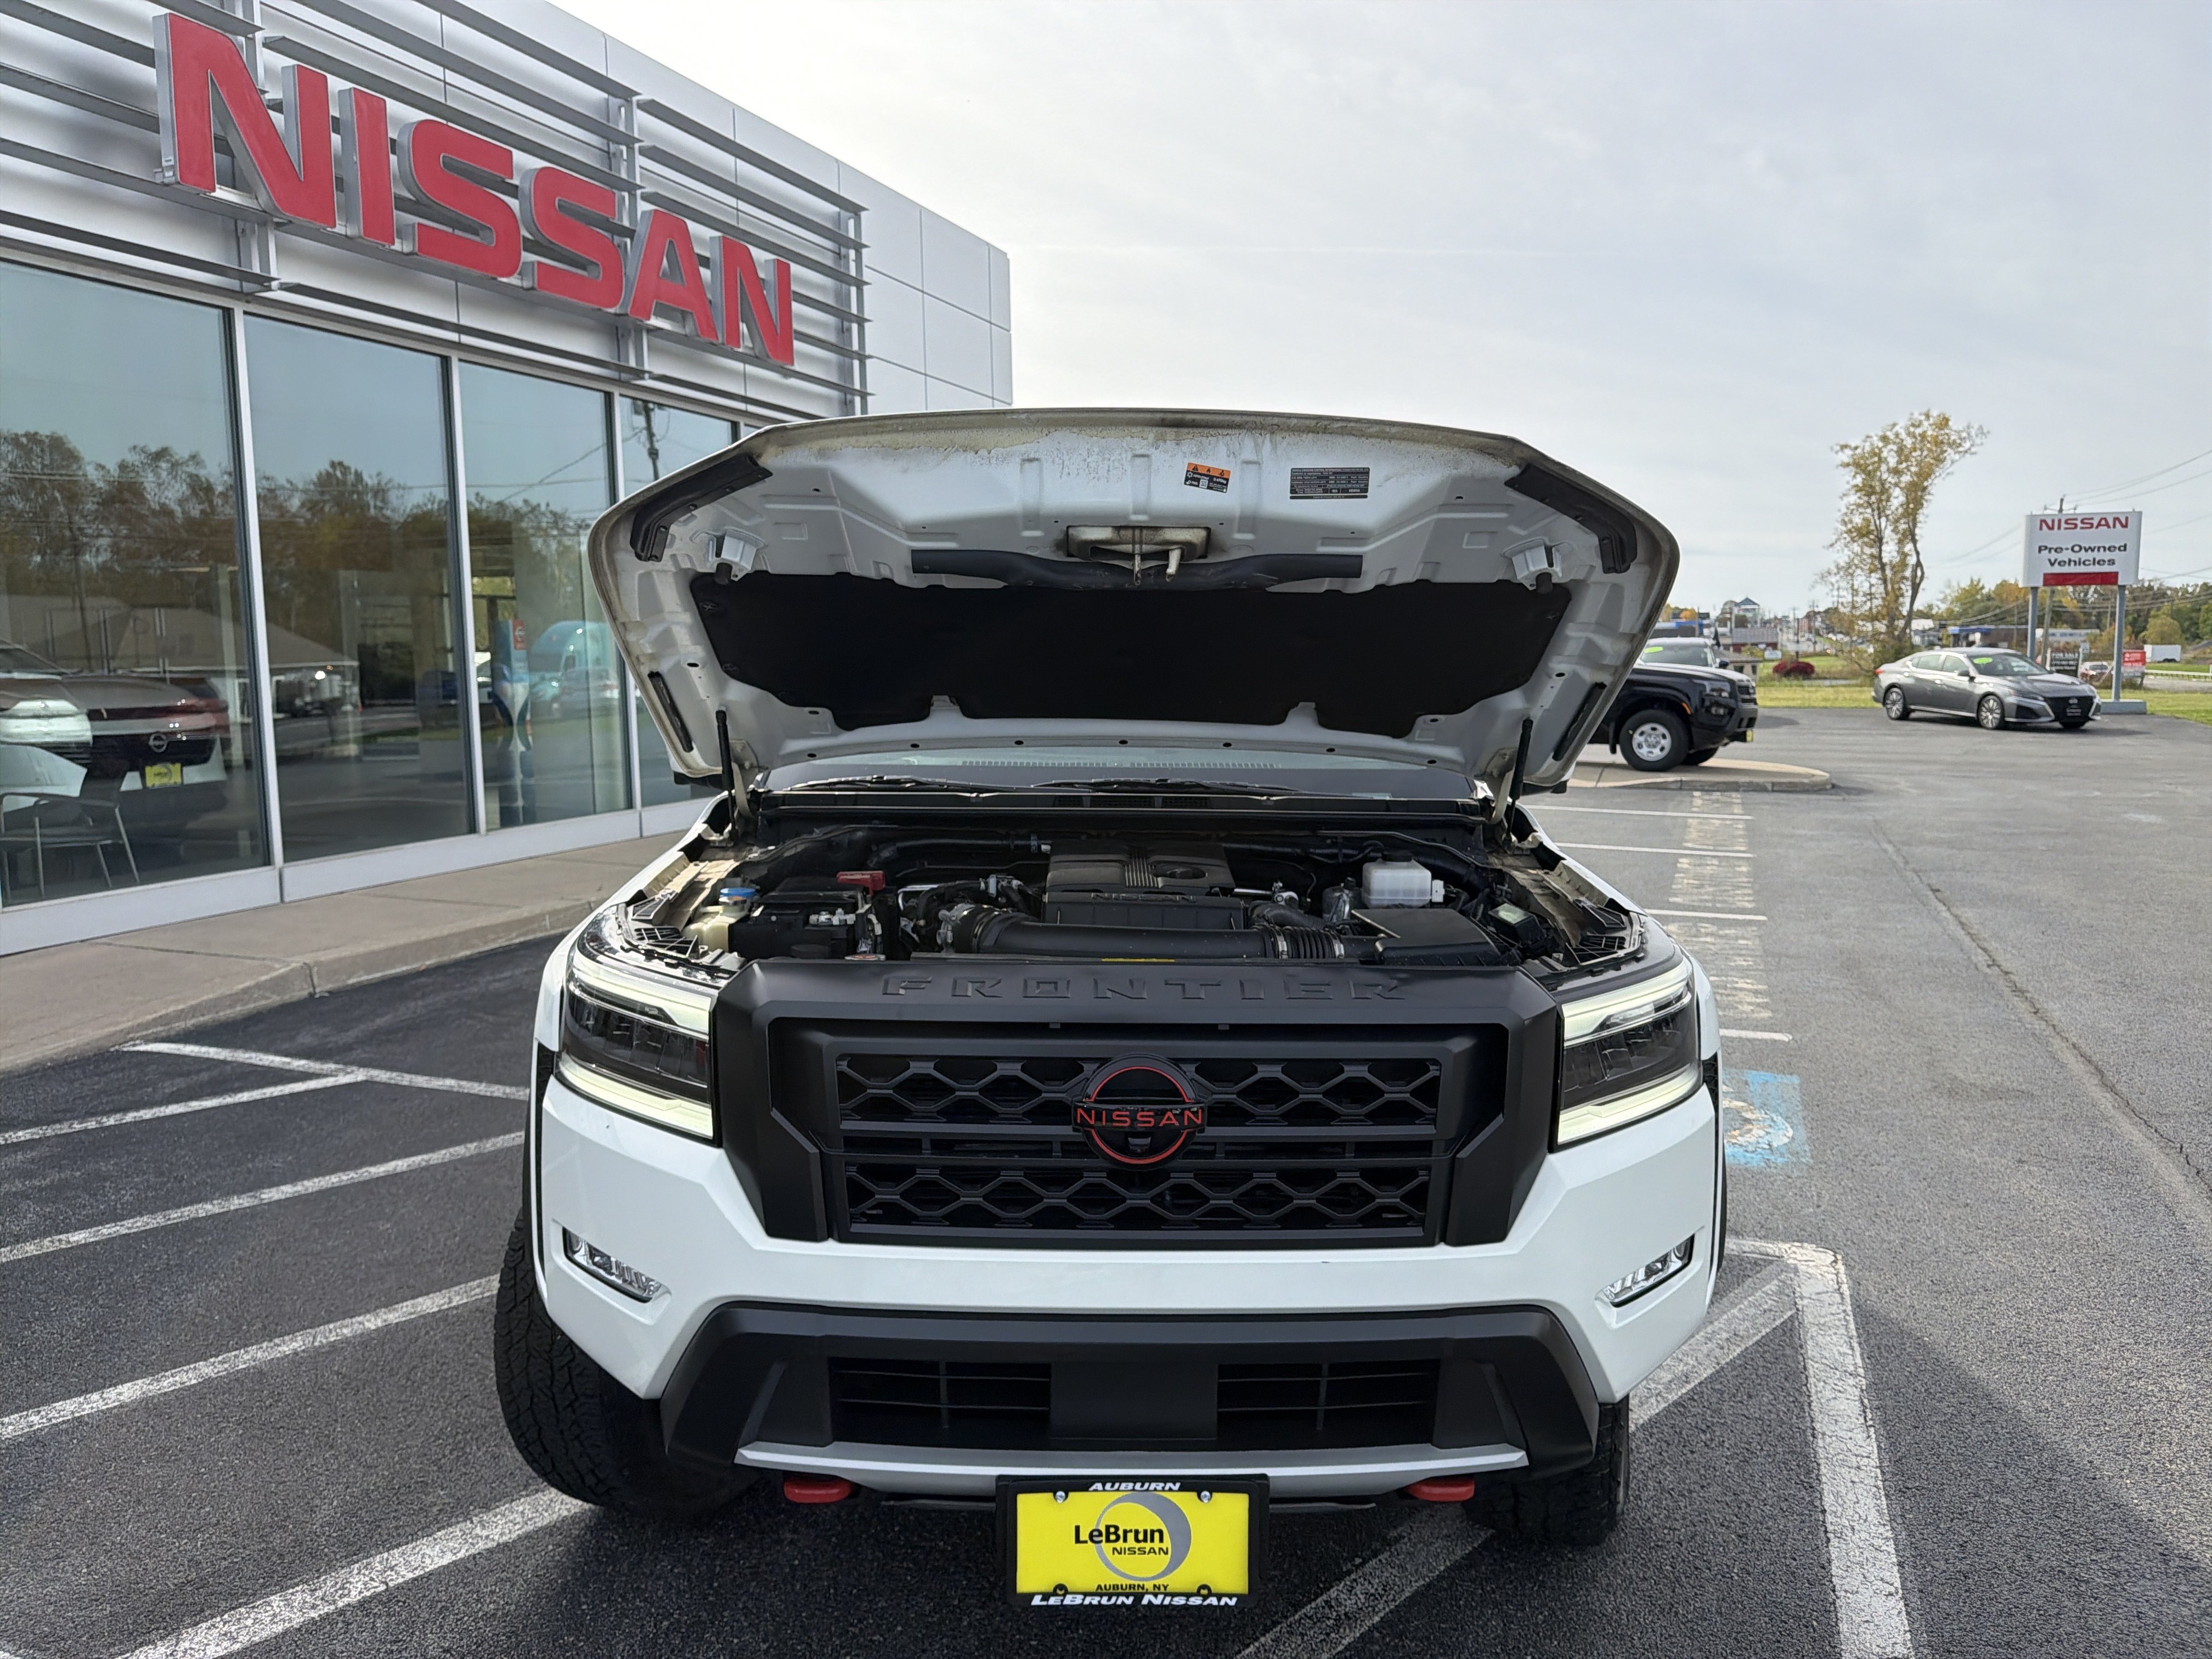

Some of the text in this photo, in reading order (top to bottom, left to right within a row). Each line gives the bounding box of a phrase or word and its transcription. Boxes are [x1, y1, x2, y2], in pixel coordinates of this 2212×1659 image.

[154, 11, 795, 367] NISSAN
[2039, 516, 2129, 531] NISSAN
[2038, 543, 2128, 555] Pre-Owned
[2047, 557, 2116, 567] Vehicles
[881, 977, 1406, 1000] FRONTIER
[1076, 1108, 1202, 1127] NISSAN
[1088, 1482, 1181, 1491] AUBURN
[1074, 1525, 1164, 1544] LeBrun
[1112, 1547, 1169, 1556] NISSAN
[1095, 1583, 1170, 1593] AUBURN, NY
